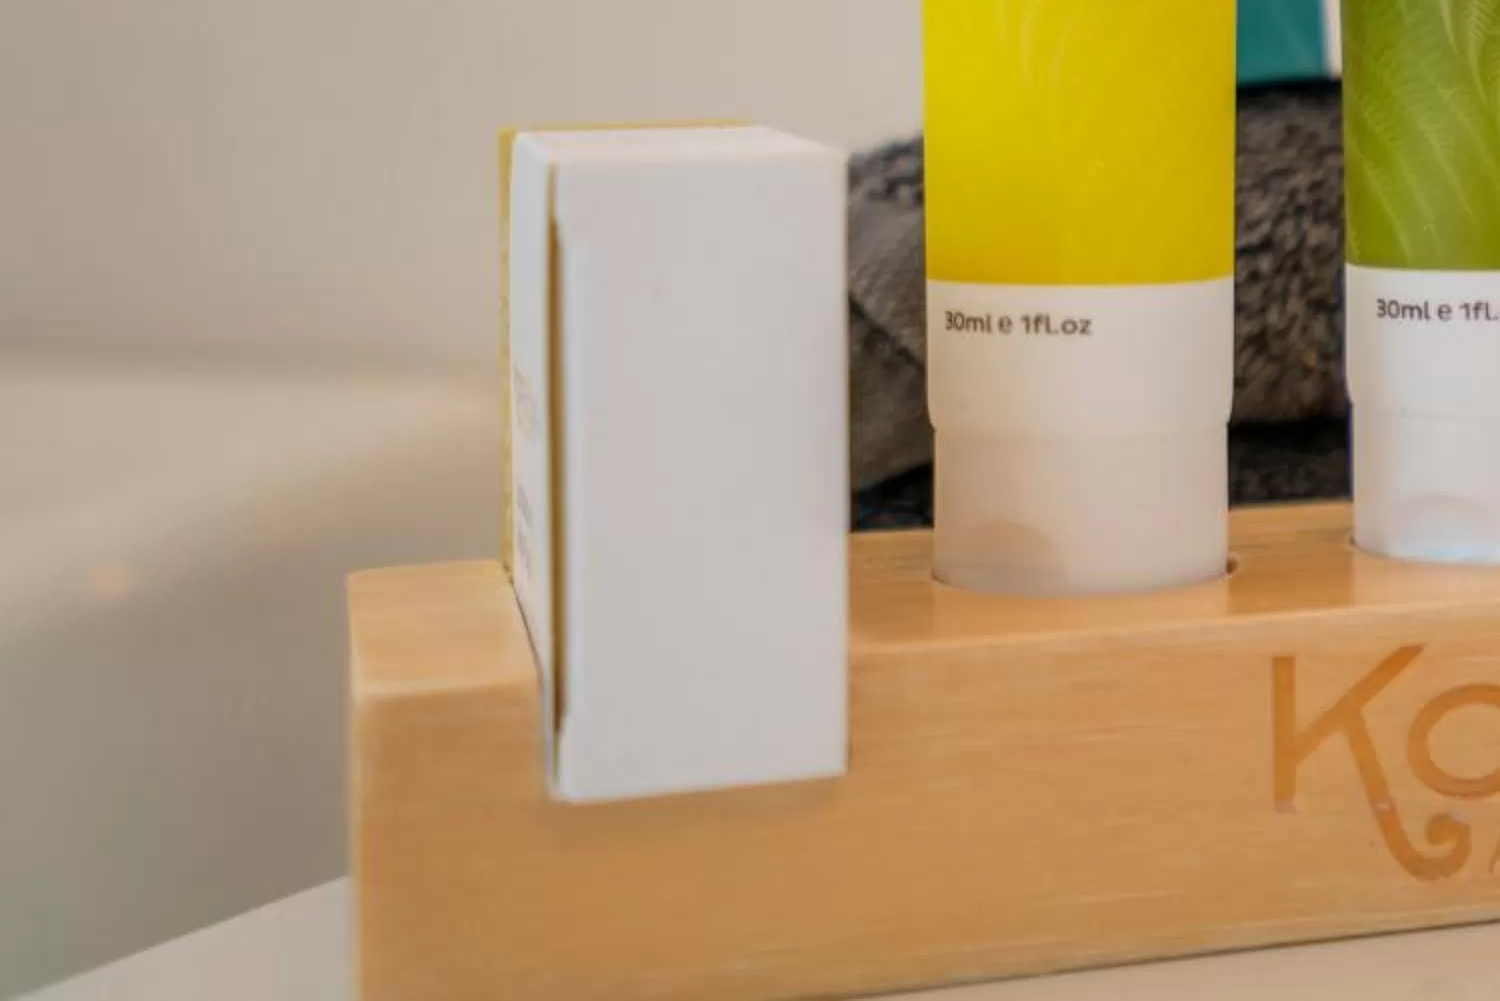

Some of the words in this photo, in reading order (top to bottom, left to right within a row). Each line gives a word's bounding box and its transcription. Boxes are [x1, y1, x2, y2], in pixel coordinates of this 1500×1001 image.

[1376, 298, 1431, 321] 30ml
[944, 310, 993, 335] 30ml
[1019, 312, 1092, 337] 1fl.oz
